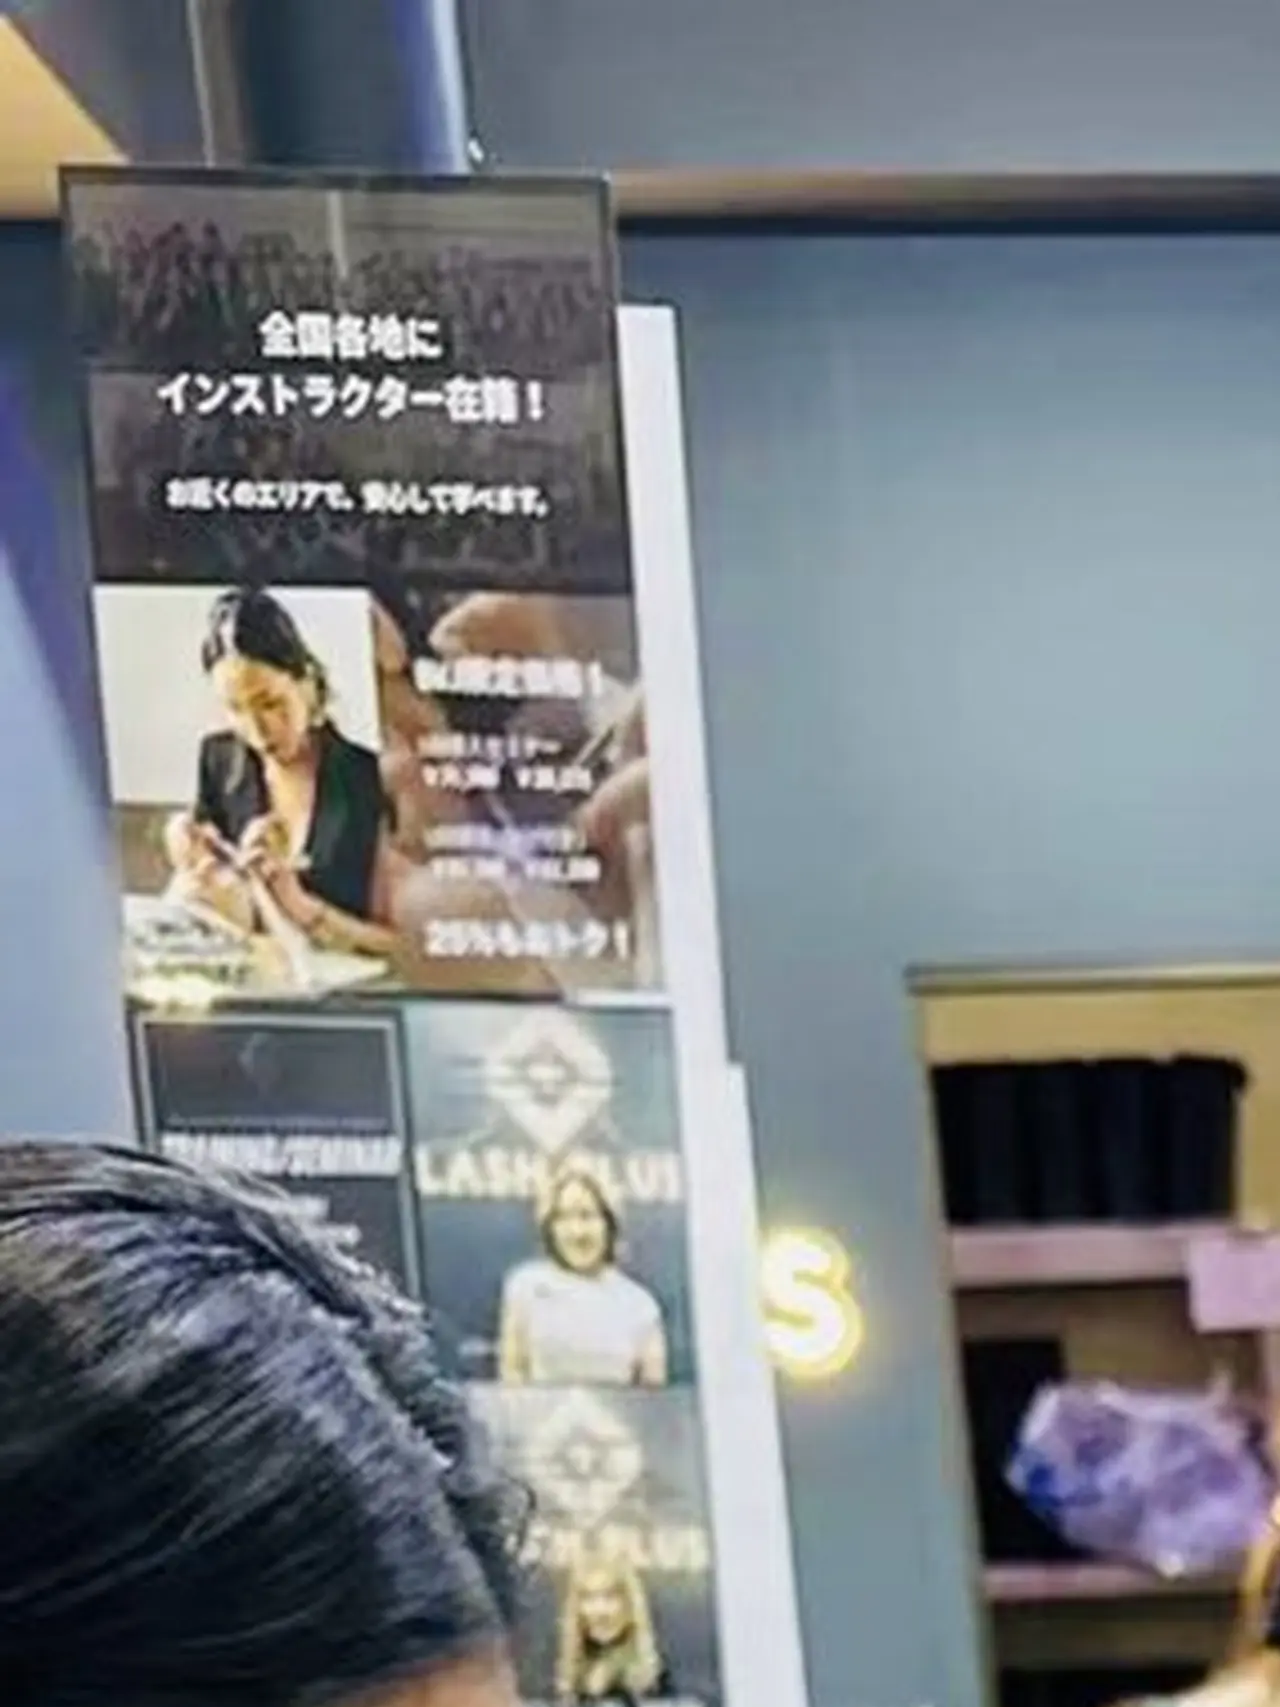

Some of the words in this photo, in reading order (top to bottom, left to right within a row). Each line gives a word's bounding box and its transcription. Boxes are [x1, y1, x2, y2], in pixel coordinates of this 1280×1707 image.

[258, 308, 444, 360] 全国各地に
[156, 371, 546, 424] インストラクター在籍！
